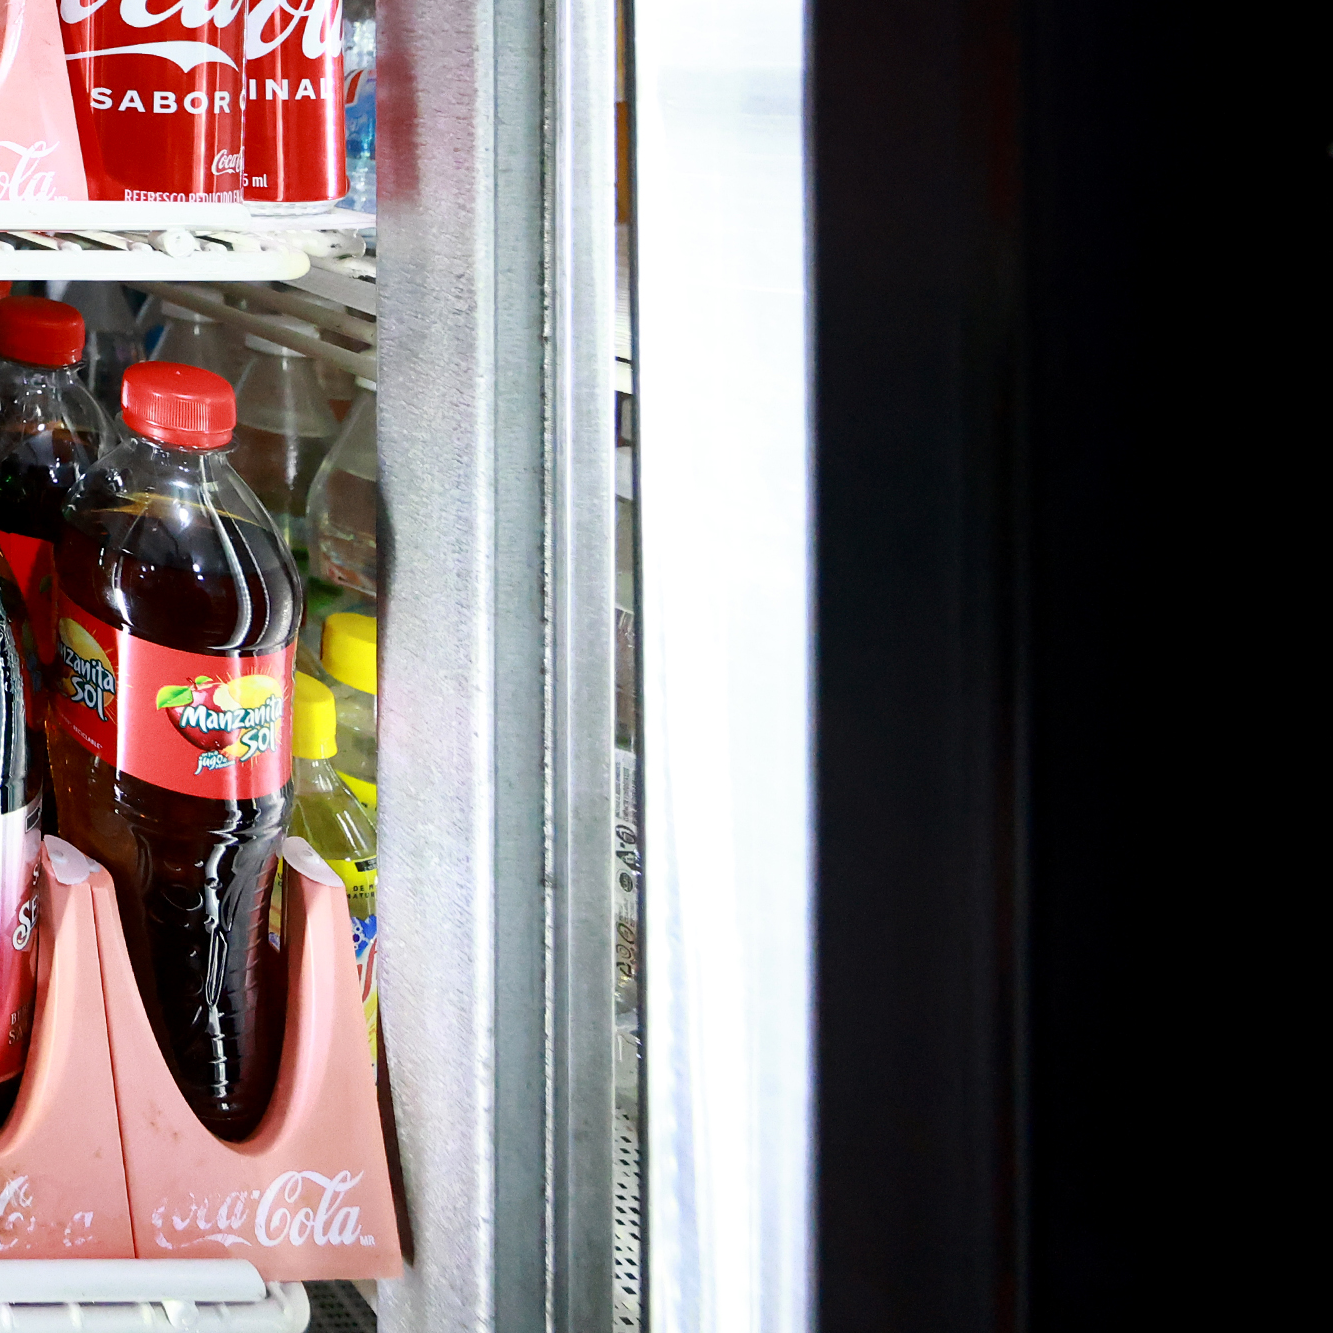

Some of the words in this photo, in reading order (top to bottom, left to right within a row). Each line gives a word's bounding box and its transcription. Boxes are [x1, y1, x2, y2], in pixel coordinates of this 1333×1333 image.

[90, 87, 231, 115] SABOR
[248, 77, 333, 101] INAL
[251, 173, 268, 188] ml
[124, 188, 186, 203] REFRESCO
[180, 693, 284, 735] Manzanita
